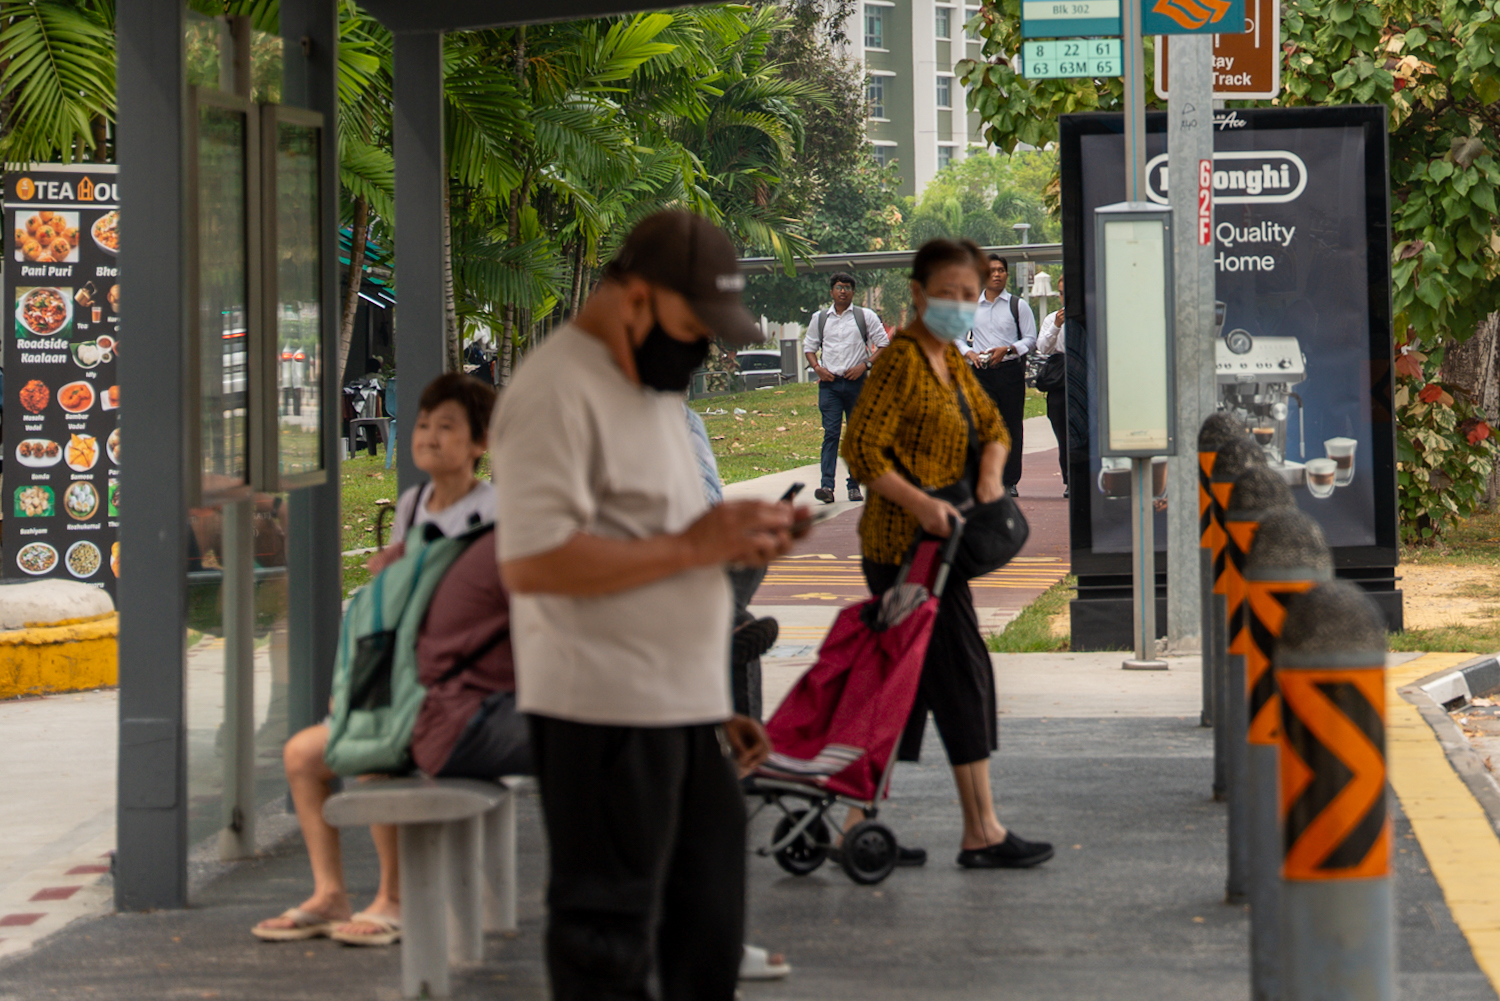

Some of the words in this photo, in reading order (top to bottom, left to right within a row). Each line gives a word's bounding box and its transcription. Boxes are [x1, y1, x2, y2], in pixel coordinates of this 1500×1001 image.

[1052, 4, 1068, 15] Blk
[1071, 4, 1090, 14] 302
[1036, 45, 1044, 57] 8
[1064, 44, 1079, 56] 22
[1096, 43, 1110, 55] 61
[1033, 62, 1049, 75] 63
[1059, 61, 1087, 74] 63M
[1096, 61, 1112, 73] 65
[1212, 55, 1234, 70] tay
[1212, 71, 1252, 86] Track
[34, 180, 75, 200] TEA
[1215, 220, 1296, 247] Quality
[1213, 251, 1275, 272] Home
[21, 265, 46, 276] Pani
[48, 265, 73, 277] Puri
[96, 266, 119, 277] Bhe
[17, 338, 69, 350] Roadside
[21, 352, 67, 364] Kaalaan
